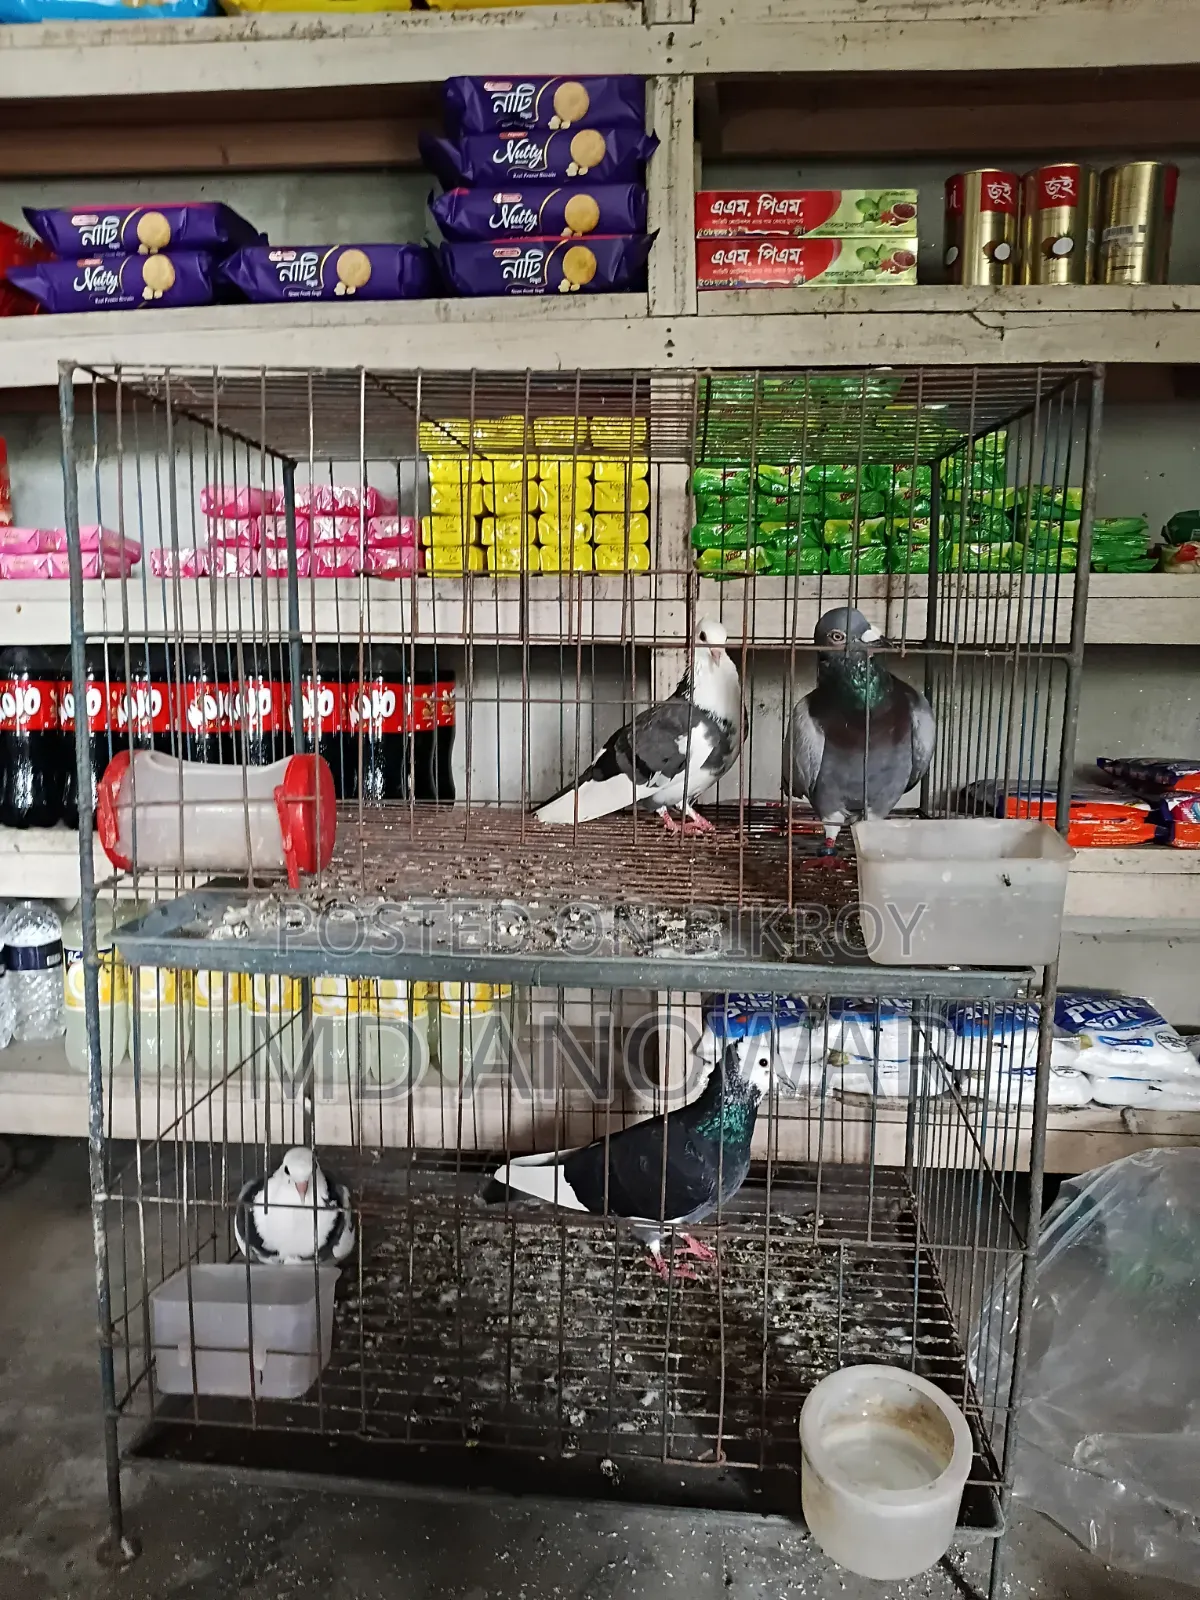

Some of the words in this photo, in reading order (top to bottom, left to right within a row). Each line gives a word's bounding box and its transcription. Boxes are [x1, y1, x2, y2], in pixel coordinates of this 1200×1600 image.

[491, 83, 536, 113] নাটি
[492, 138, 544, 169] Nutty
[488, 203, 538, 232] Nutty
[710, 199, 752, 218] এএম.
[756, 193, 805, 218] পিএম.
[79, 215, 121, 247] নাটি
[276, 252, 319, 282] নাটি
[501, 249, 544, 279] নাটি
[711, 249, 753, 267] এএম.
[757, 243, 805, 266] পিএম.
[73, 265, 119, 295] Nutty
